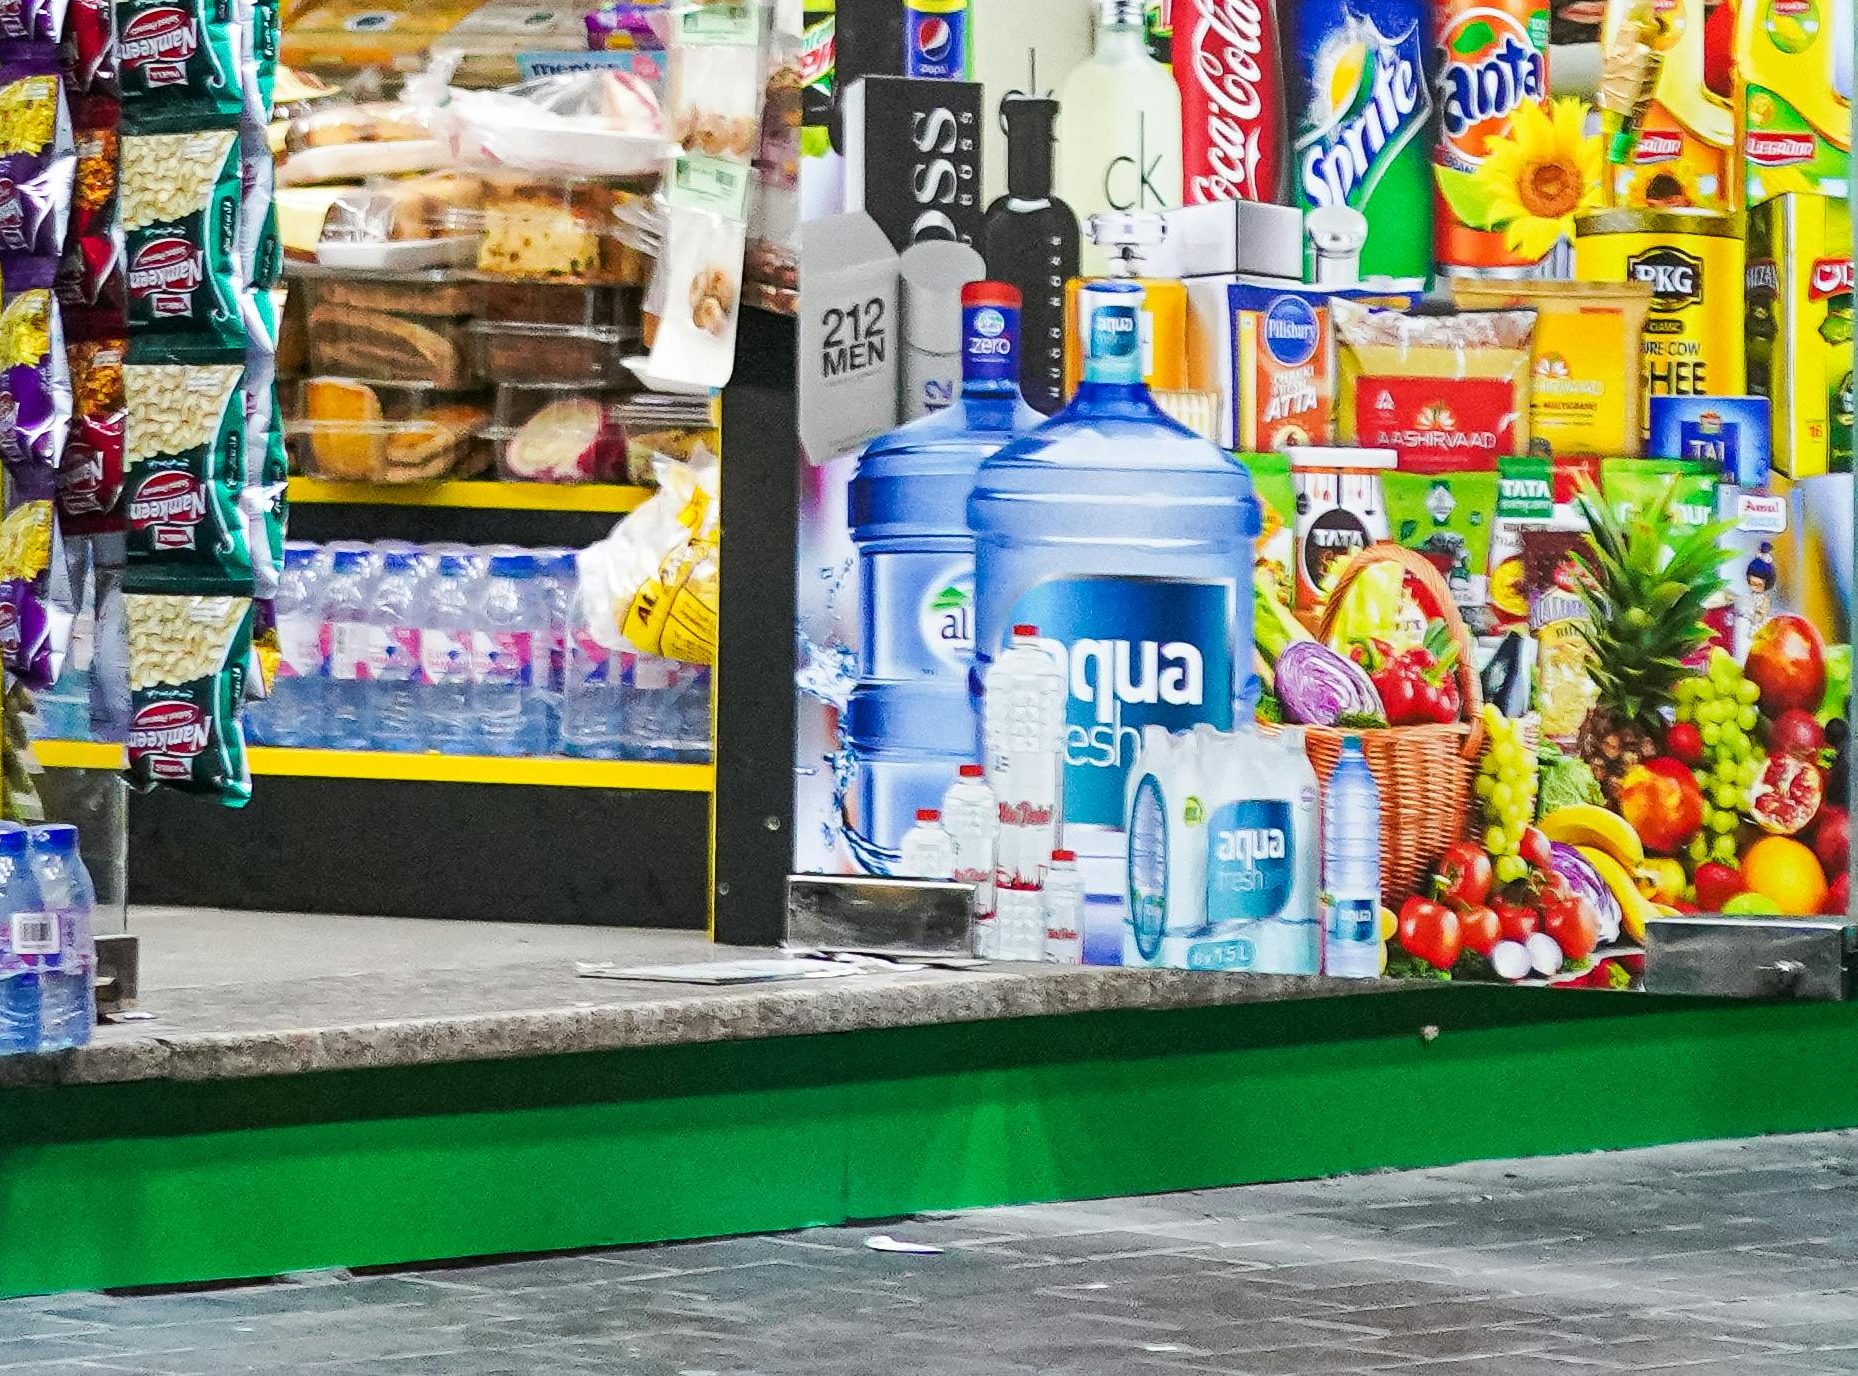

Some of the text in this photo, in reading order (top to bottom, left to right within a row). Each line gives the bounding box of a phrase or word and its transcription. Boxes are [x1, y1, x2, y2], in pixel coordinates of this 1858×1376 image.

[119, 19, 198, 67] Namkeen
[1442, 35, 1545, 137] anta
[1303, 46, 1420, 209] Sprite
[127, 248, 205, 294] Namkeen
[821, 296, 886, 346] 212
[1268, 317, 1316, 341] Pillsbury
[822, 335, 886, 378] MEN
[969, 336, 1011, 357] zero
[1670, 341, 1701, 356] COW
[1648, 360, 1707, 395] HEE
[1265, 390, 1318, 422] ATTA
[1376, 426, 1497, 450] AASHIRVAAD
[1500, 478, 1551, 499] TATA
[127, 487, 207, 529] Namkeen
[1312, 529, 1369, 550] TATA
[127, 712, 211, 757] Namkeen
[1217, 829, 1285, 863] aqua
